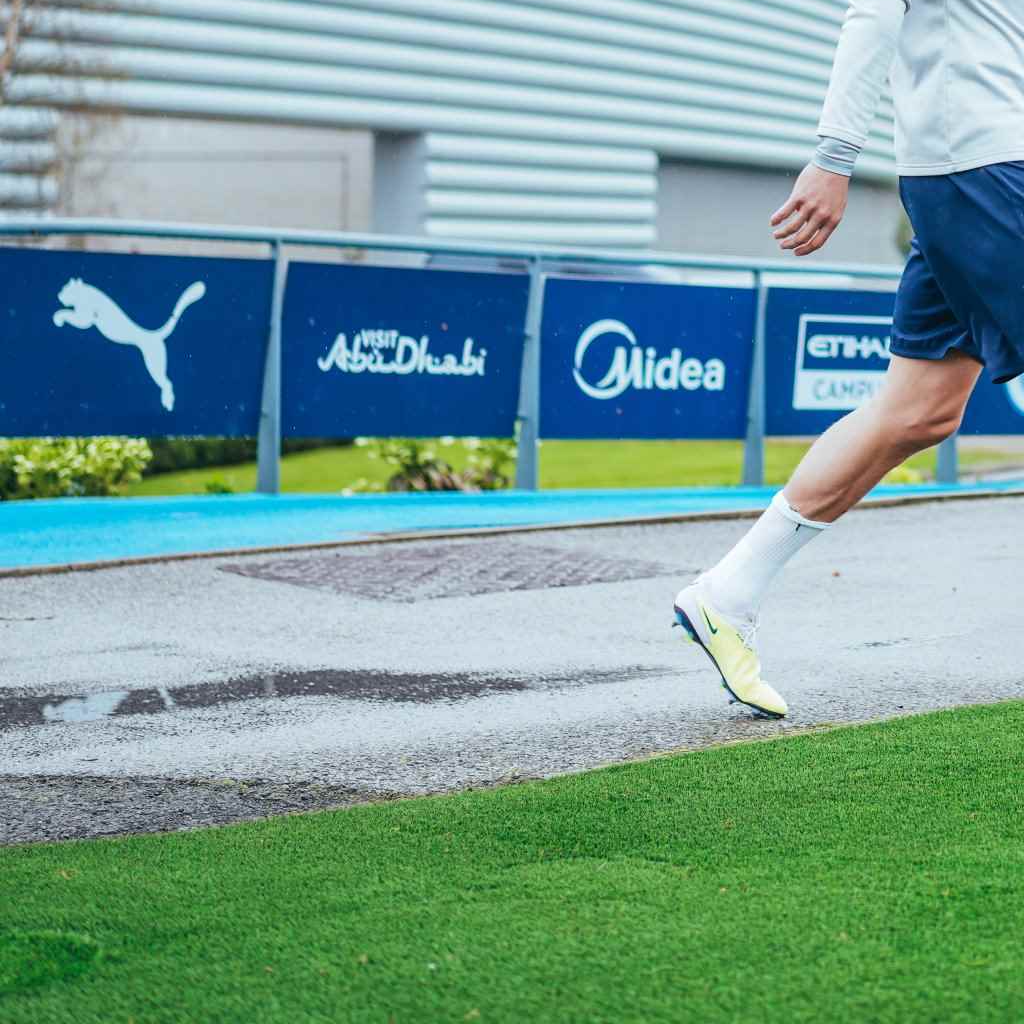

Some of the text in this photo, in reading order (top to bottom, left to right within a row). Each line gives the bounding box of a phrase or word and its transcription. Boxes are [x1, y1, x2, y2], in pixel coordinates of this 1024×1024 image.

[361, 328, 399, 349] VISIT
[807, 334, 890, 359] ETIHA
[596, 346, 726, 391] Midea
